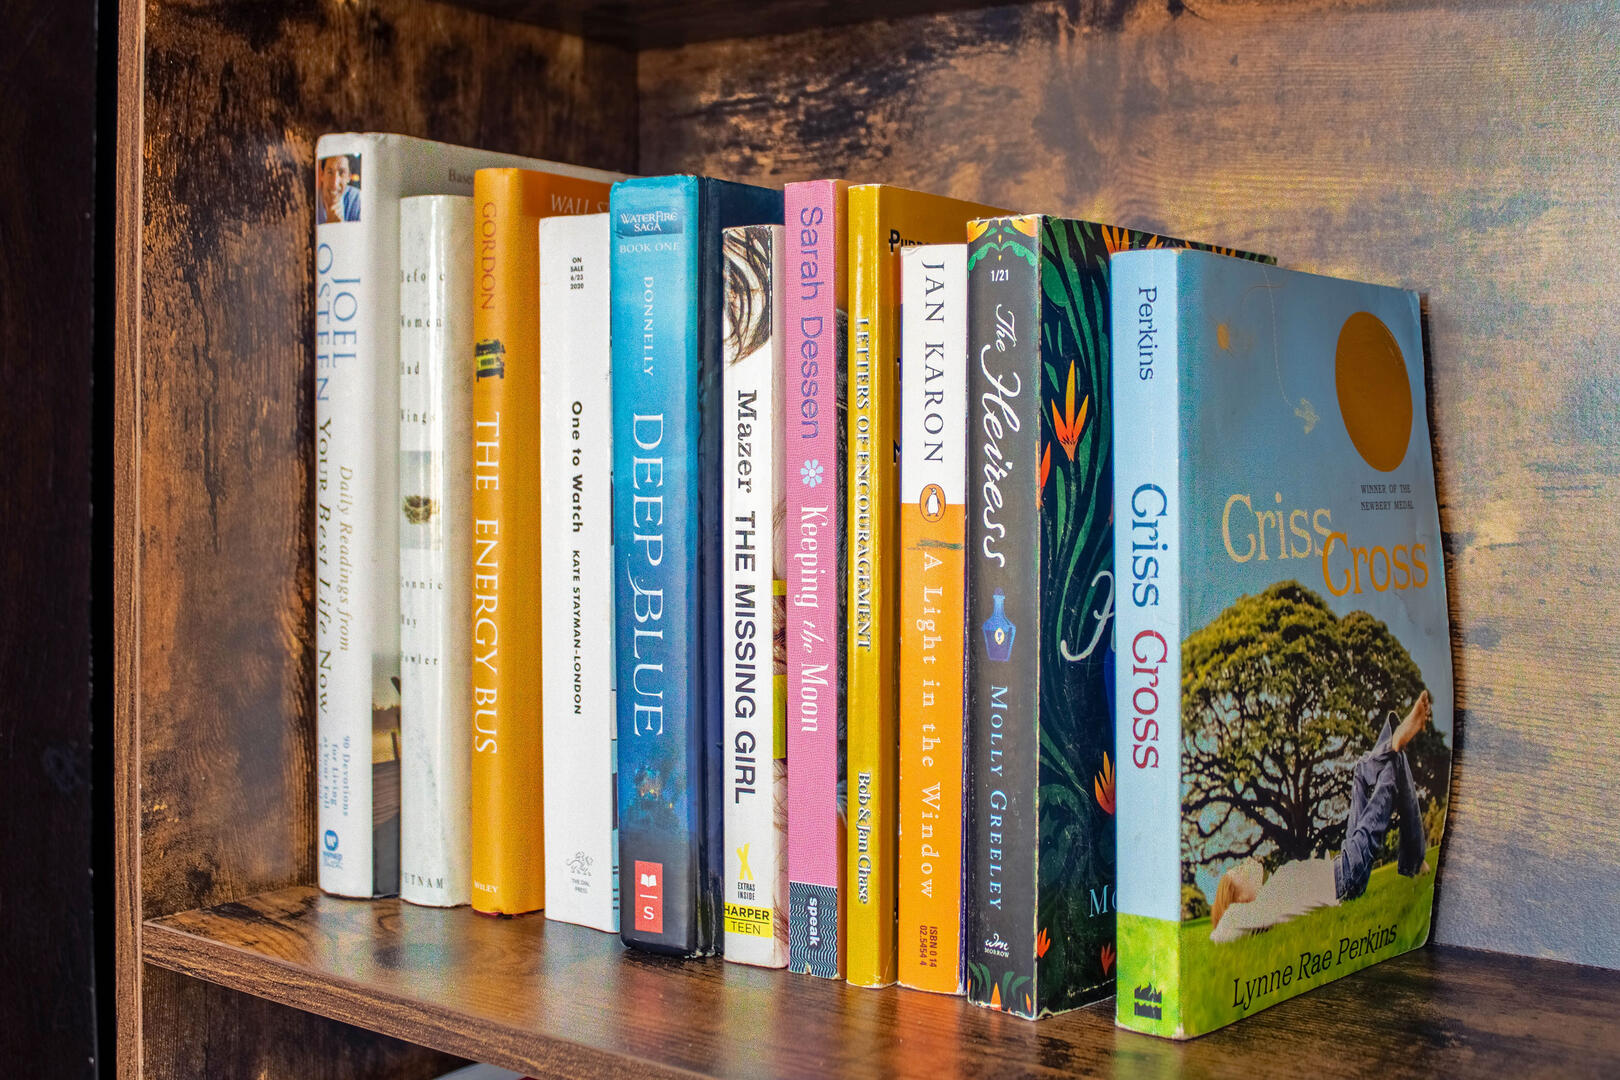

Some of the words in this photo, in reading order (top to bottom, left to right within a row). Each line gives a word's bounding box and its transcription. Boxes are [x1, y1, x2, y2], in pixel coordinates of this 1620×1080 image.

[619, 243, 651, 254] BOOK
[655, 241, 681, 252] ONE
[620, 209, 680, 225] WATERFIRE
[633, 222, 662, 232] SAGA
[481, 202, 497, 310] GORDON
[571, 256, 583, 264] ON
[801, 206, 825, 300] Sarah
[990, 269, 1009, 282] 1/21
[570, 282, 585, 290] 2020
[921, 260, 945, 324] JAN
[316, 242, 334, 401] OSTEEN
[331, 277, 361, 368] JOEL
[643, 276, 655, 377] DONNELLY
[995, 303, 1017, 353] The
[1138, 286, 1157, 381] Perkins
[801, 316, 823, 439] Dessen
[856, 317, 870, 409] LETTERS
[571, 401, 583, 440] One
[857, 415, 870, 445] OF
[923, 341, 945, 463] KARON
[475, 411, 500, 490] THE
[572, 448, 582, 467] to
[737, 390, 758, 494] Mazer
[981, 344, 1021, 568] Heiress
[337, 465, 353, 515] Daily
[572, 474, 584, 533] Watch
[633, 413, 664, 567] DEEP
[1360, 484, 1386, 494] WINNER
[1389, 484, 1397, 494] OF
[1399, 484, 1411, 494] THE
[1360, 501, 1390, 511] NEWBERY
[1394, 500, 1414, 510] MEDAL
[337, 521, 353, 605] Readings
[572, 550, 581, 582] KATE
[735, 510, 756, 572] THE
[794, 504, 829, 609] Keeping
[857, 451, 871, 652] ENCOURAGEMENT
[923, 552, 943, 572] A
[1131, 483, 1168, 608] Criss
[1222, 491, 1335, 563] Criss
[1322, 531, 1429, 597] Cross
[475, 518, 500, 676] ENERGY
[916, 586, 943, 664] Light
[337, 608, 353, 652] from
[572, 586, 582, 715] STAYMAN-LONDON
[629, 566, 664, 737] BLUE
[735, 583, 756, 719] MISSING
[800, 619, 825, 654] the
[474, 687, 499, 754] BUS
[801, 662, 829, 733] Moon
[922, 679, 941, 707] in
[1131, 629, 1169, 769] Cross
[921, 722, 941, 768] the
[990, 686, 1008, 777] MOLLY
[342, 753, 351, 817] Devotions
[735, 730, 756, 804] GIRL
[858, 771, 871, 805] Bob
[856, 822, 871, 852] Jan
[858, 806, 871, 822] &
[920, 781, 941, 898] Window
[858, 854, 871, 904] Chase
[989, 790, 1007, 911] GREELEY
[643, 905, 655, 920] S
[724, 905, 770, 921] HARPER
[737, 882, 756, 892] EXTRAS
[737, 891, 755, 901] INSIDE
[731, 920, 761, 935] TEEN
[806, 897, 819, 947] speak
[929, 925, 938, 949] ISBN
[984, 947, 1010, 958] MORROW
[1232, 964, 1293, 1011] Lynne
[1297, 952, 1332, 982] Rae
[1336, 924, 1398, 966] Perkins
